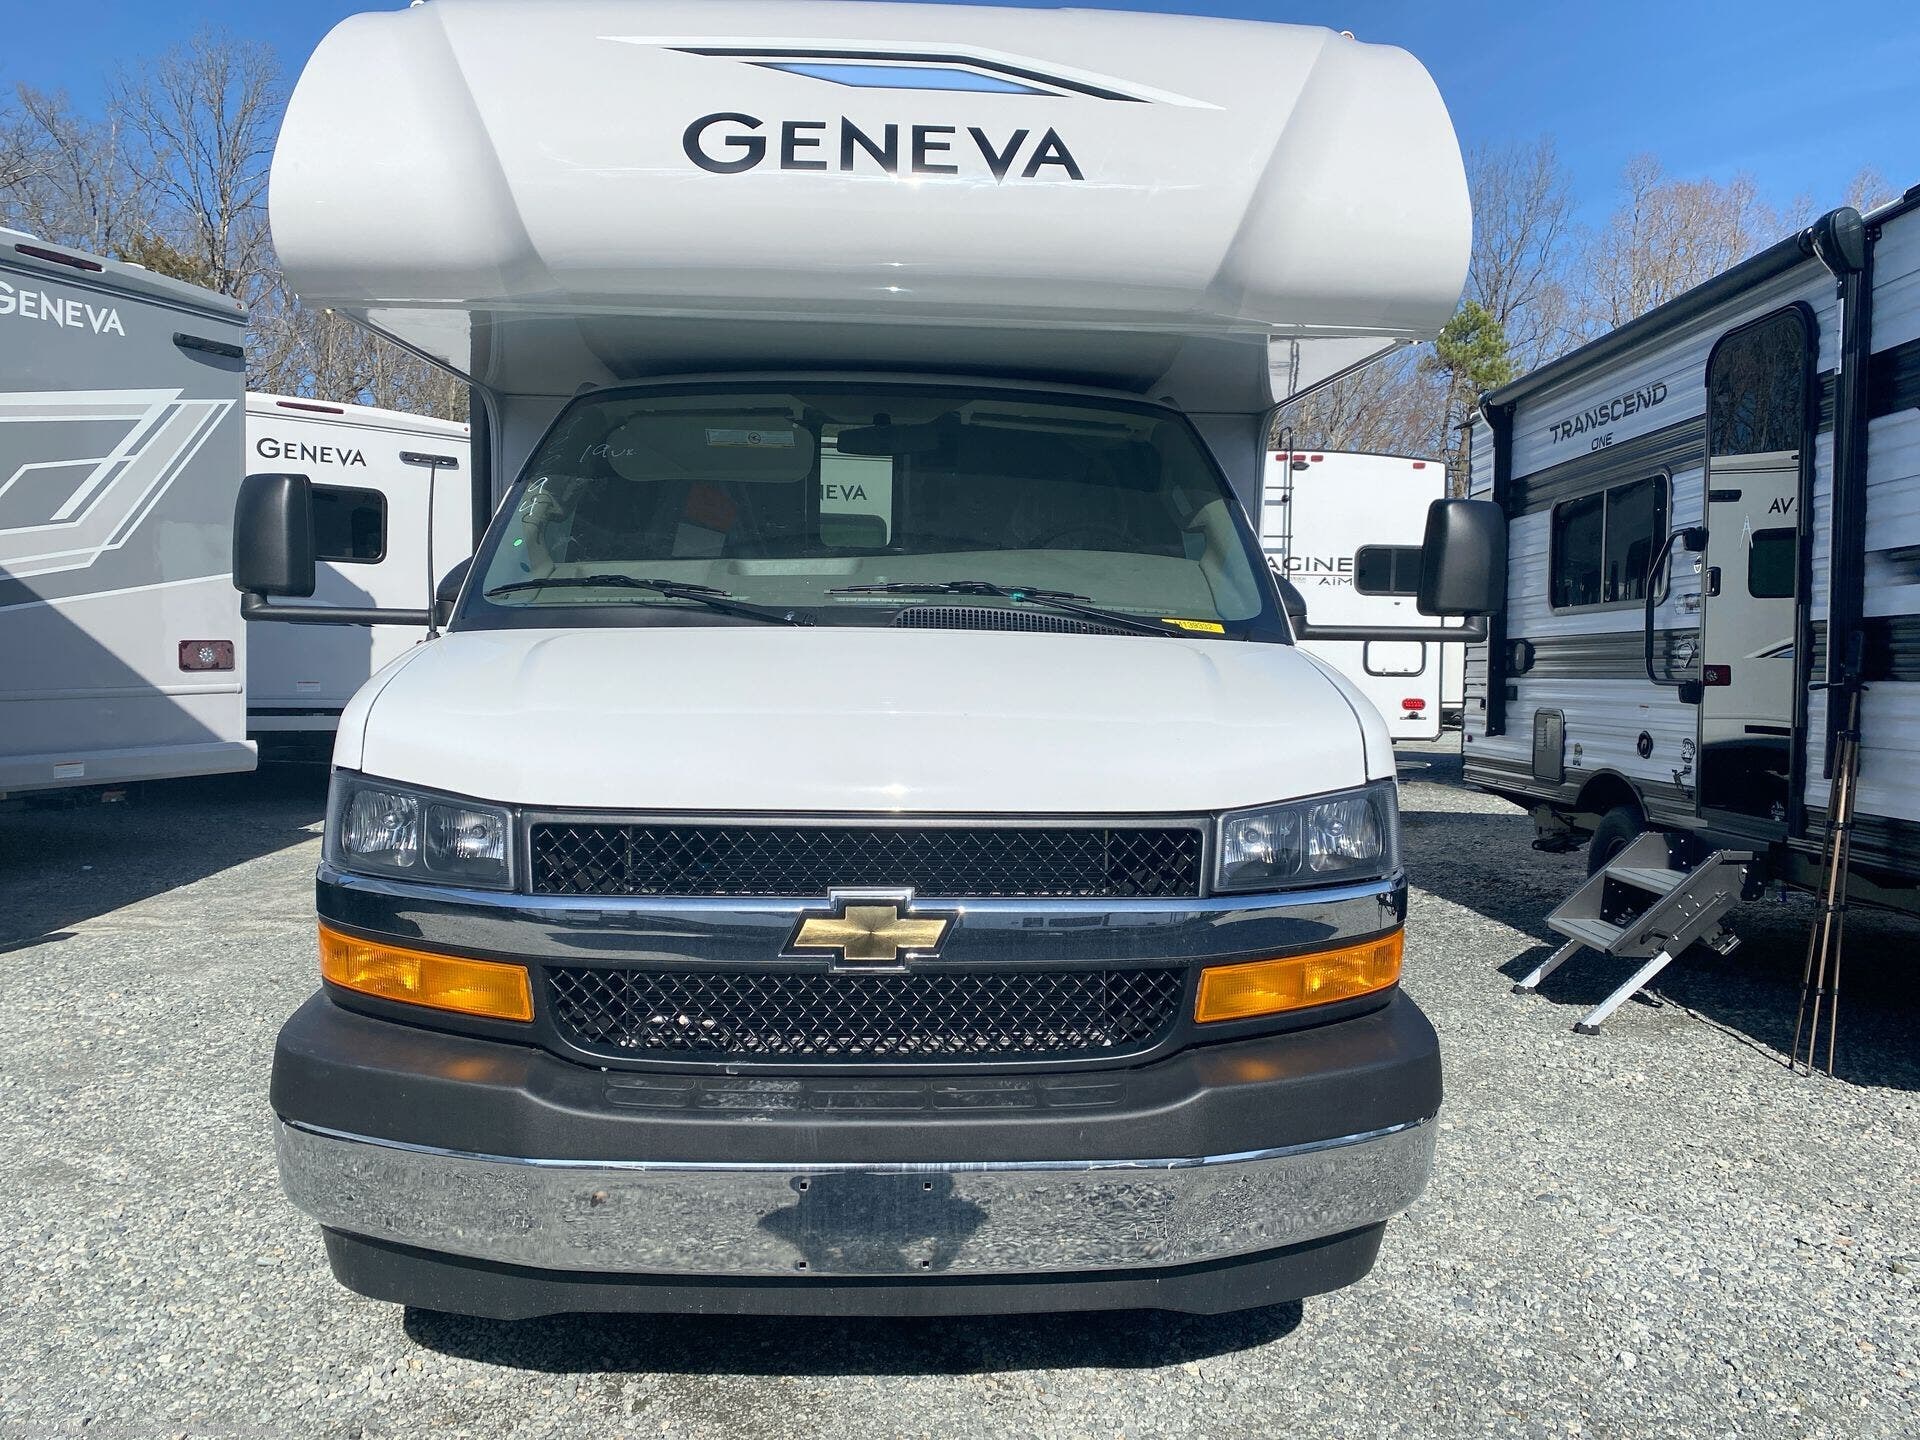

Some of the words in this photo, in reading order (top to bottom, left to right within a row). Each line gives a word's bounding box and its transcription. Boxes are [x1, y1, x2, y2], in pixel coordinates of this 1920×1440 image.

[682, 112, 1085, 186] GENEVA
[0, 281, 126, 337] GENEVA
[1549, 382, 1668, 444] TRANSCEND
[256, 437, 367, 467] GENEVA
[1591, 432, 1614, 451] ONE
